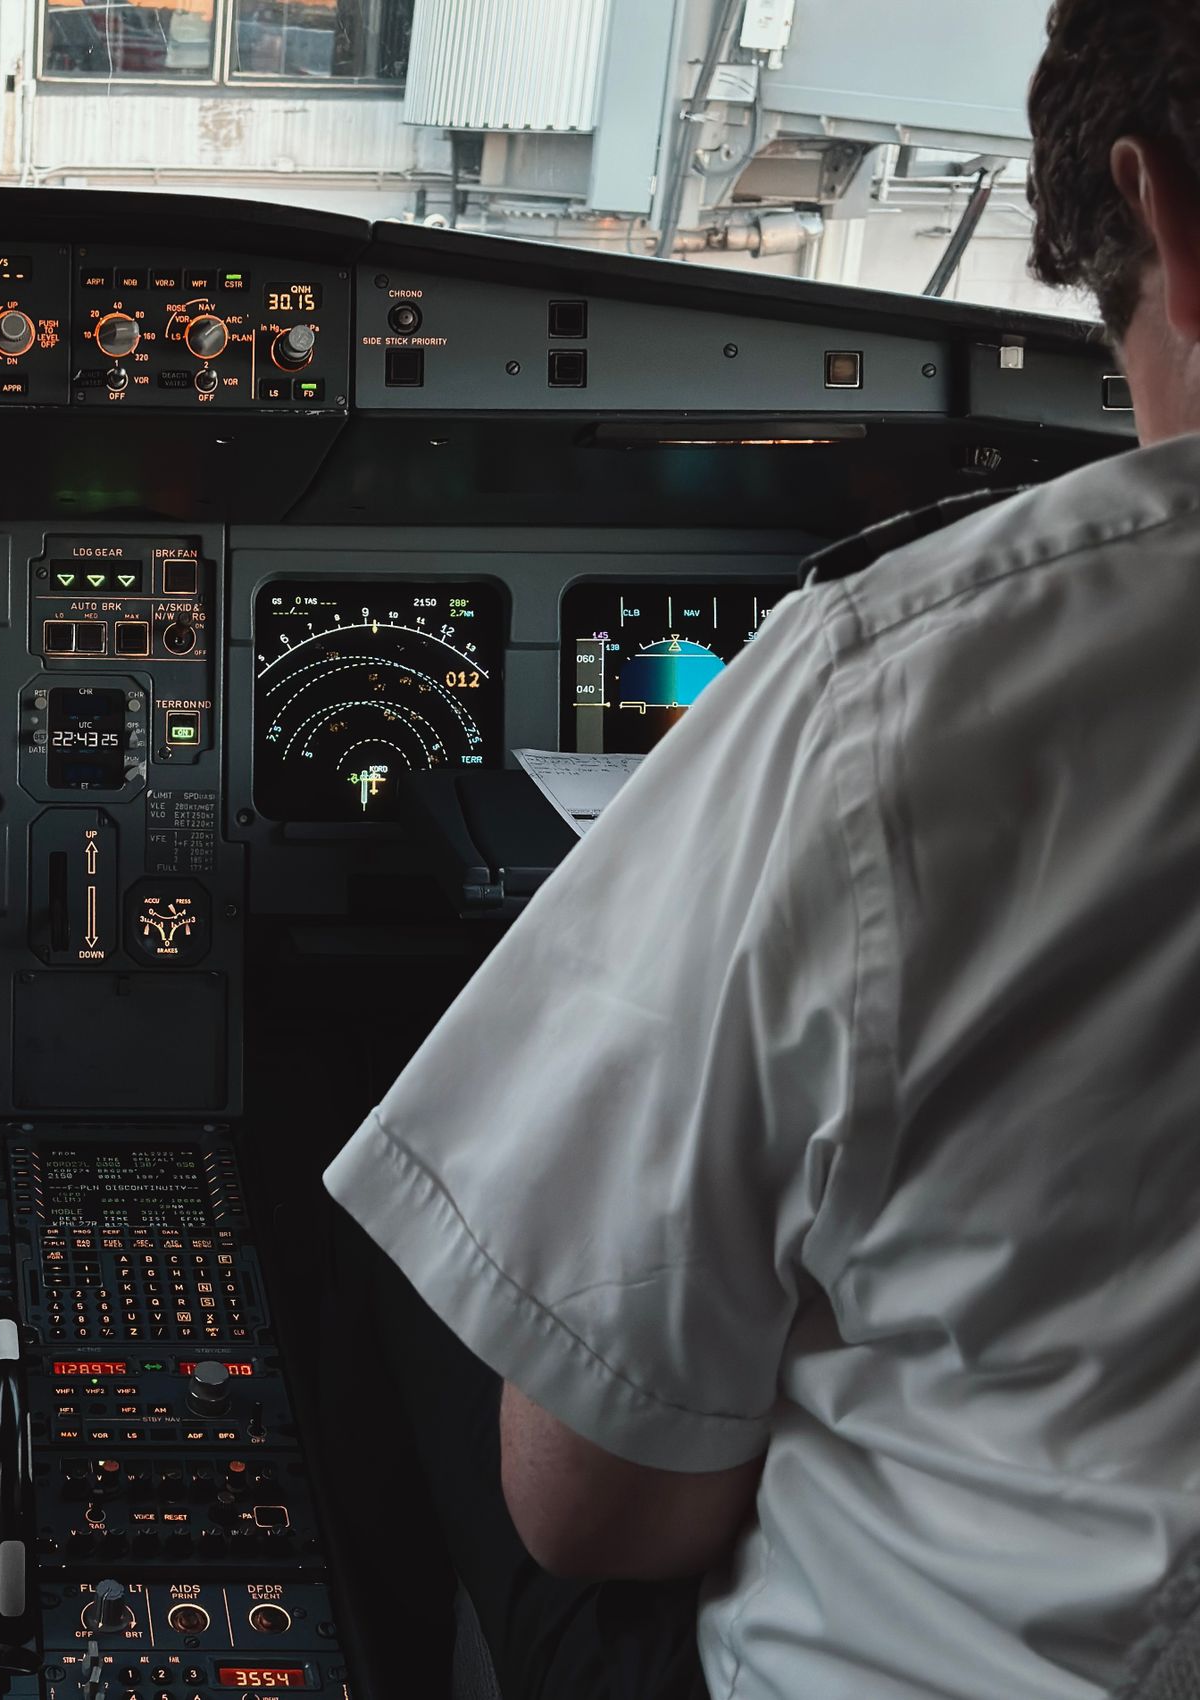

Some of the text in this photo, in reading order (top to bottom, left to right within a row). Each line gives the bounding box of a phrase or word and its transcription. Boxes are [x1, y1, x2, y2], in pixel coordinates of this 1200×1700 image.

[290, 285, 312, 294] QNH
[388, 289, 423, 298] CHRONO
[7, 301, 19, 310] UP
[268, 293, 315, 311] 30.15
[198, 303, 216, 311] NAV
[225, 315, 243, 324] ARC
[231, 333, 253, 342] PLAN
[362, 336, 448, 346] SIDE STICK PRIORITY
[2, 384, 22, 392] APPR
[73, 547, 123, 557] LDG GEAR
[155, 549, 198, 558] BRK FAN
[303, 597, 318, 605] TAS
[413, 597, 437, 607] 2150
[70, 601, 122, 611] AUTO BRK
[157, 603, 192, 612] A/SKID
[683, 609, 701, 617] NAV
[445, 671, 480, 689] 012
[155, 699, 212, 709] TERR ON ND
[78, 721, 93, 729] UTC
[52, 731, 98, 747] 22:43
[101, 733, 119, 746] 25
[461, 755, 483, 764] TERR
[85, 830, 98, 839] UP
[78, 950, 105, 959] DOWN
[169, 1584, 201, 1593] AIDS
[247, 1584, 283, 1594] DFDR
[251, 1592, 280, 1600] EVENT
[75, 1630, 94, 1638] OFF
[125, 1631, 143, 1639] BRT
[235, 1669, 290, 1687] 3554
